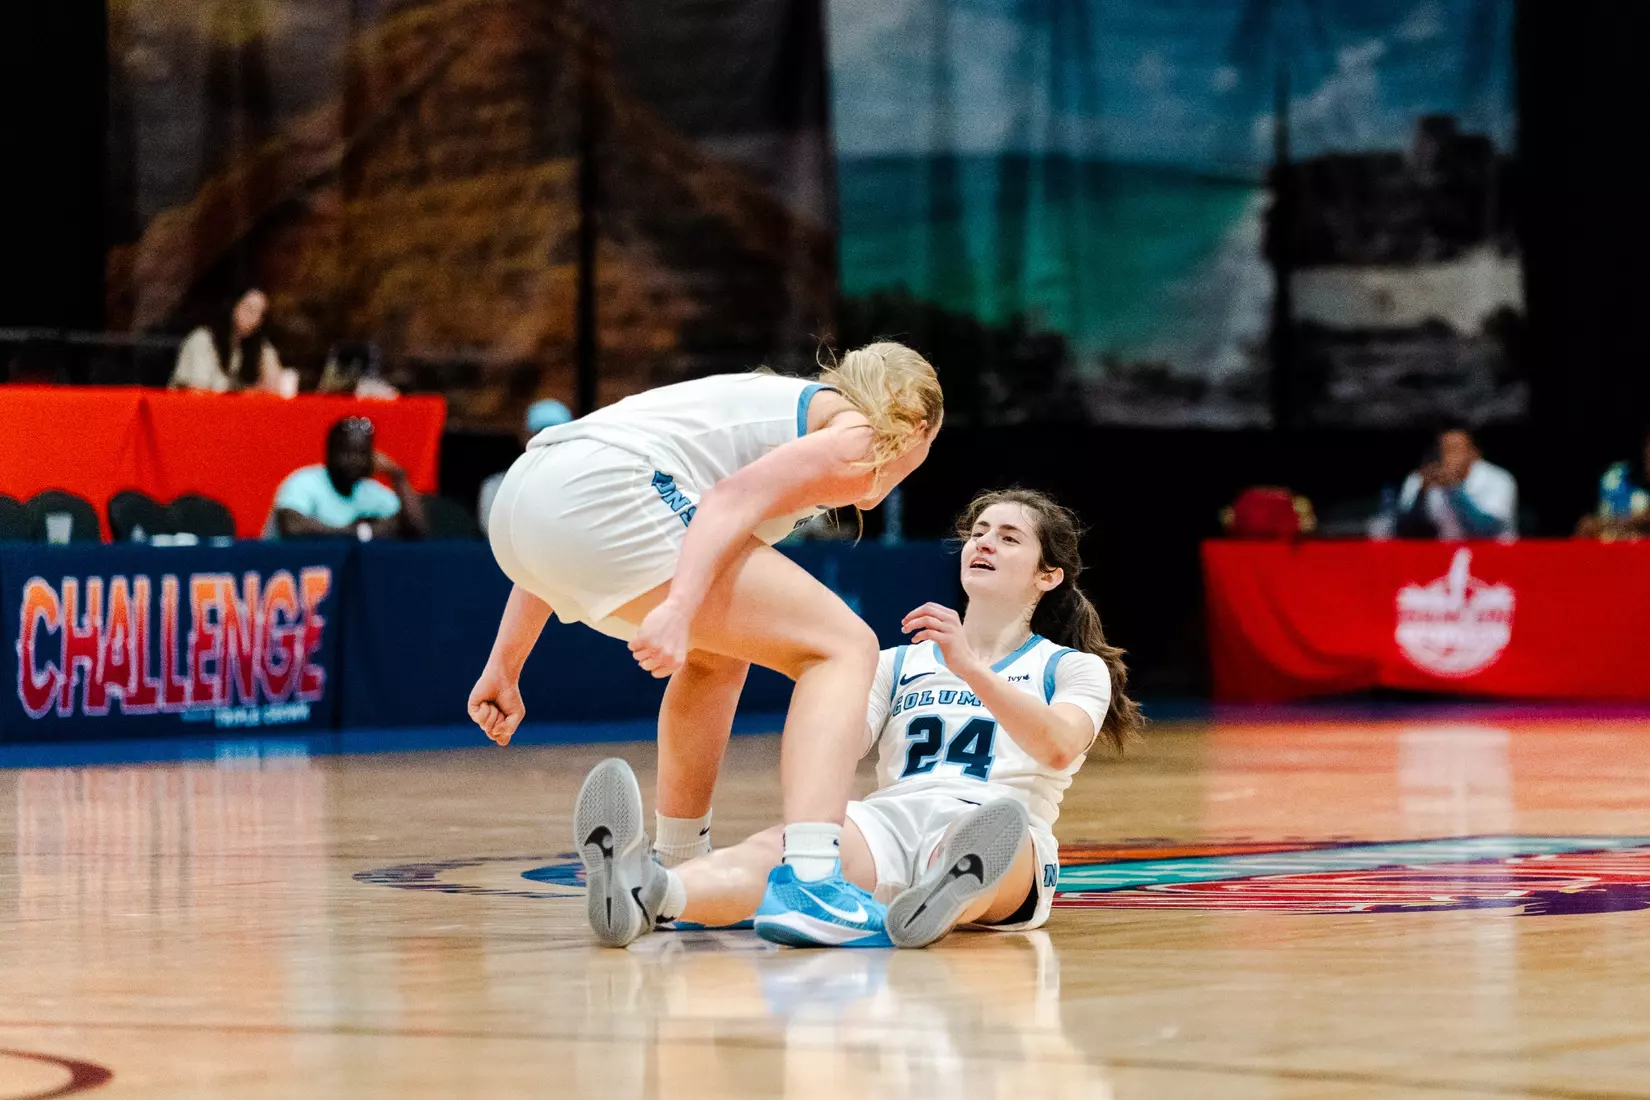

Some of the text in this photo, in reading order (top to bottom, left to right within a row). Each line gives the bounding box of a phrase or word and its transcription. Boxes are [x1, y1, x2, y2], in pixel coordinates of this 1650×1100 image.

[16, 565, 332, 720] CHALLENGE
[892, 689, 986, 717] COLUM
[898, 713, 998, 783] 24
